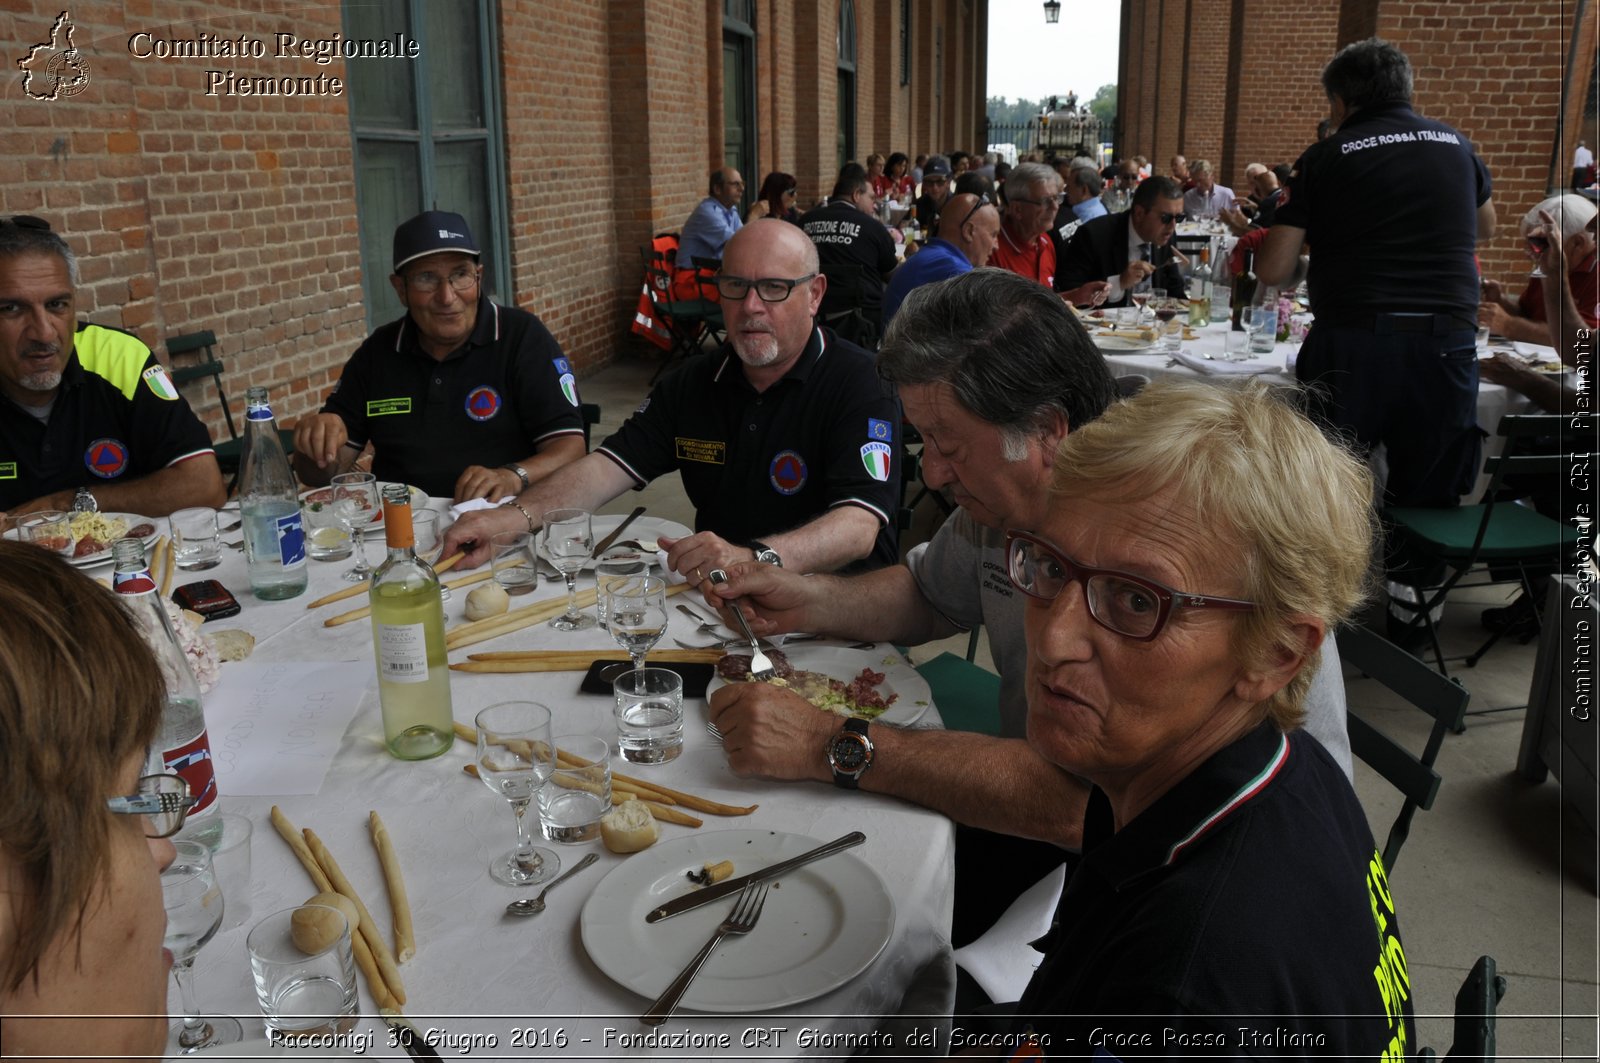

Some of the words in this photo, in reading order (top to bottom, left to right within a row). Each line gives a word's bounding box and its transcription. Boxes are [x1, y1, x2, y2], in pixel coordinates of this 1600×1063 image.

[1341, 136, 1379, 154] CROCE
[1378, 131, 1416, 145] ROSSA
[1416, 130, 1461, 145] ITALIANA
[840, 221, 861, 237] CIVILE
[811, 234, 853, 245] EINASCO
